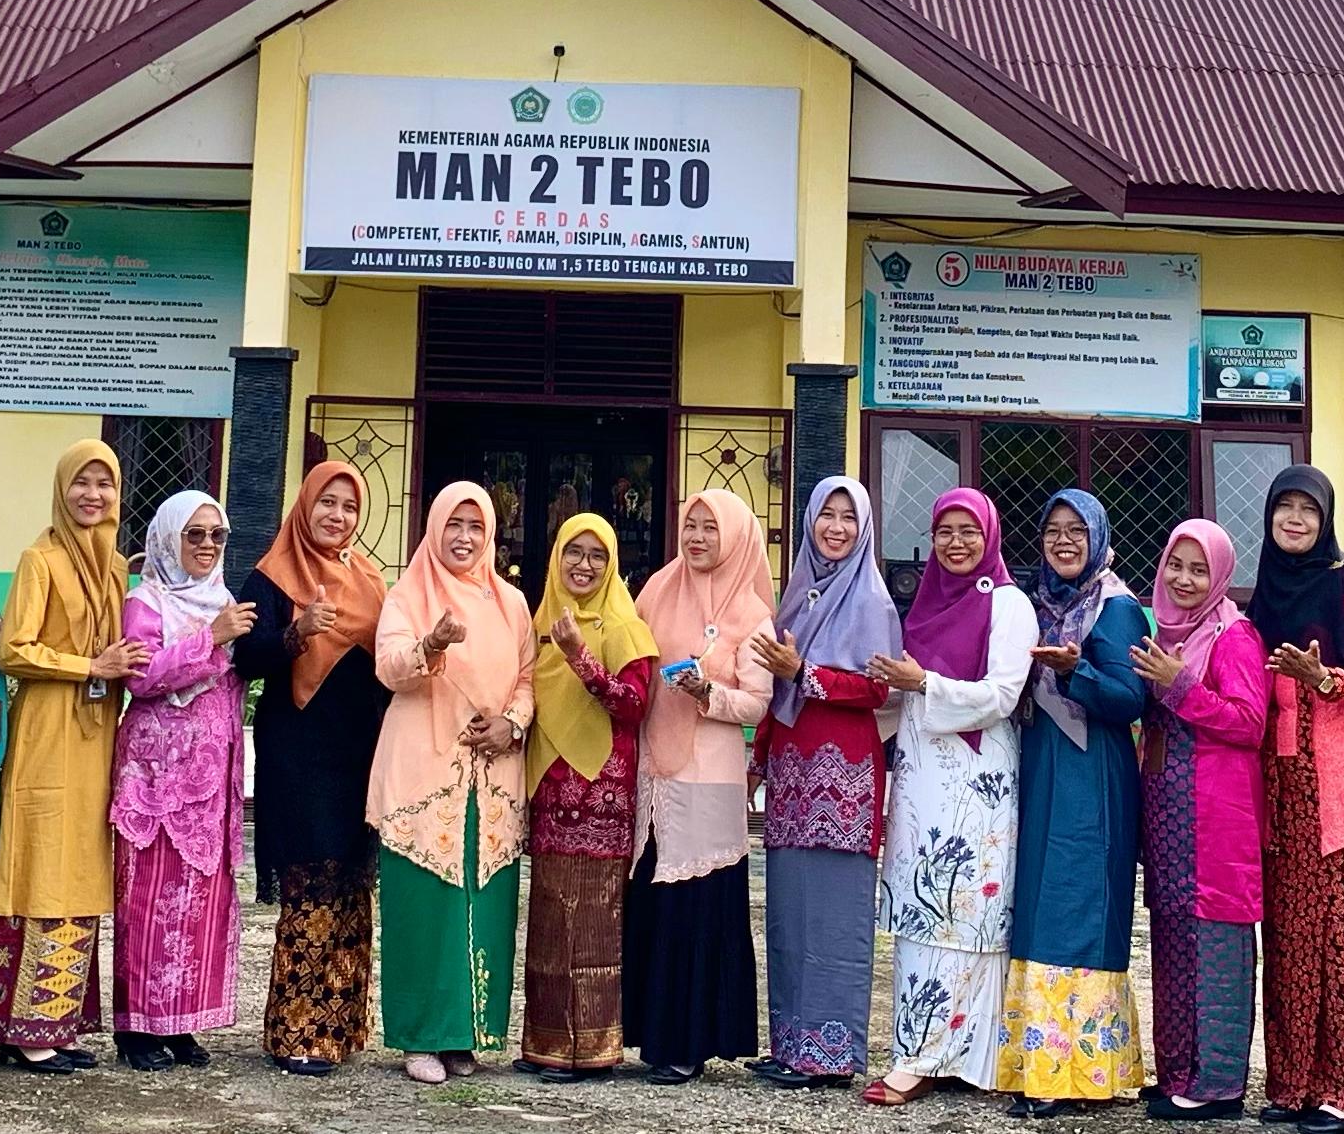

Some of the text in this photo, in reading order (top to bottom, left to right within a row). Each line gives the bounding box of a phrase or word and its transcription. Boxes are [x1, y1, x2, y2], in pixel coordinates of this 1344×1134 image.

[399, 130, 709, 152] KEMENTERIAN AGAMA REPUBLIK INDONESIA
[396, 151, 708, 208] MAN 2 TEBO
[494, 209, 608, 228] CERDAS
[17, 240, 81, 250] MAN 2 TEBO
[352, 225, 749, 251] (COMPETENT, EFEKTIF, RAMAH, DISIPLIN, AGAMIS, SANTUN)
[351, 252, 747, 276] JALAN LINTAS TEBO-BUNGO KM 1,5 TEBO TENGAH KAB. TEBO
[944, 255, 1126, 282] 5 NILAI BUDAYA KERJA
[1005, 273, 1095, 292] MAN 2 TEBO
[881, 291, 934, 301] 1. INTEGRITAS
[880, 313, 958, 324] 2. PROFESIONALITAS
[879, 336, 923, 345] 3. INOVATIF
[888, 358, 929, 368] TANGGUNG
[932, 360, 958, 368] JAWAB
[878, 381, 942, 391] 5. KETELADANAN
